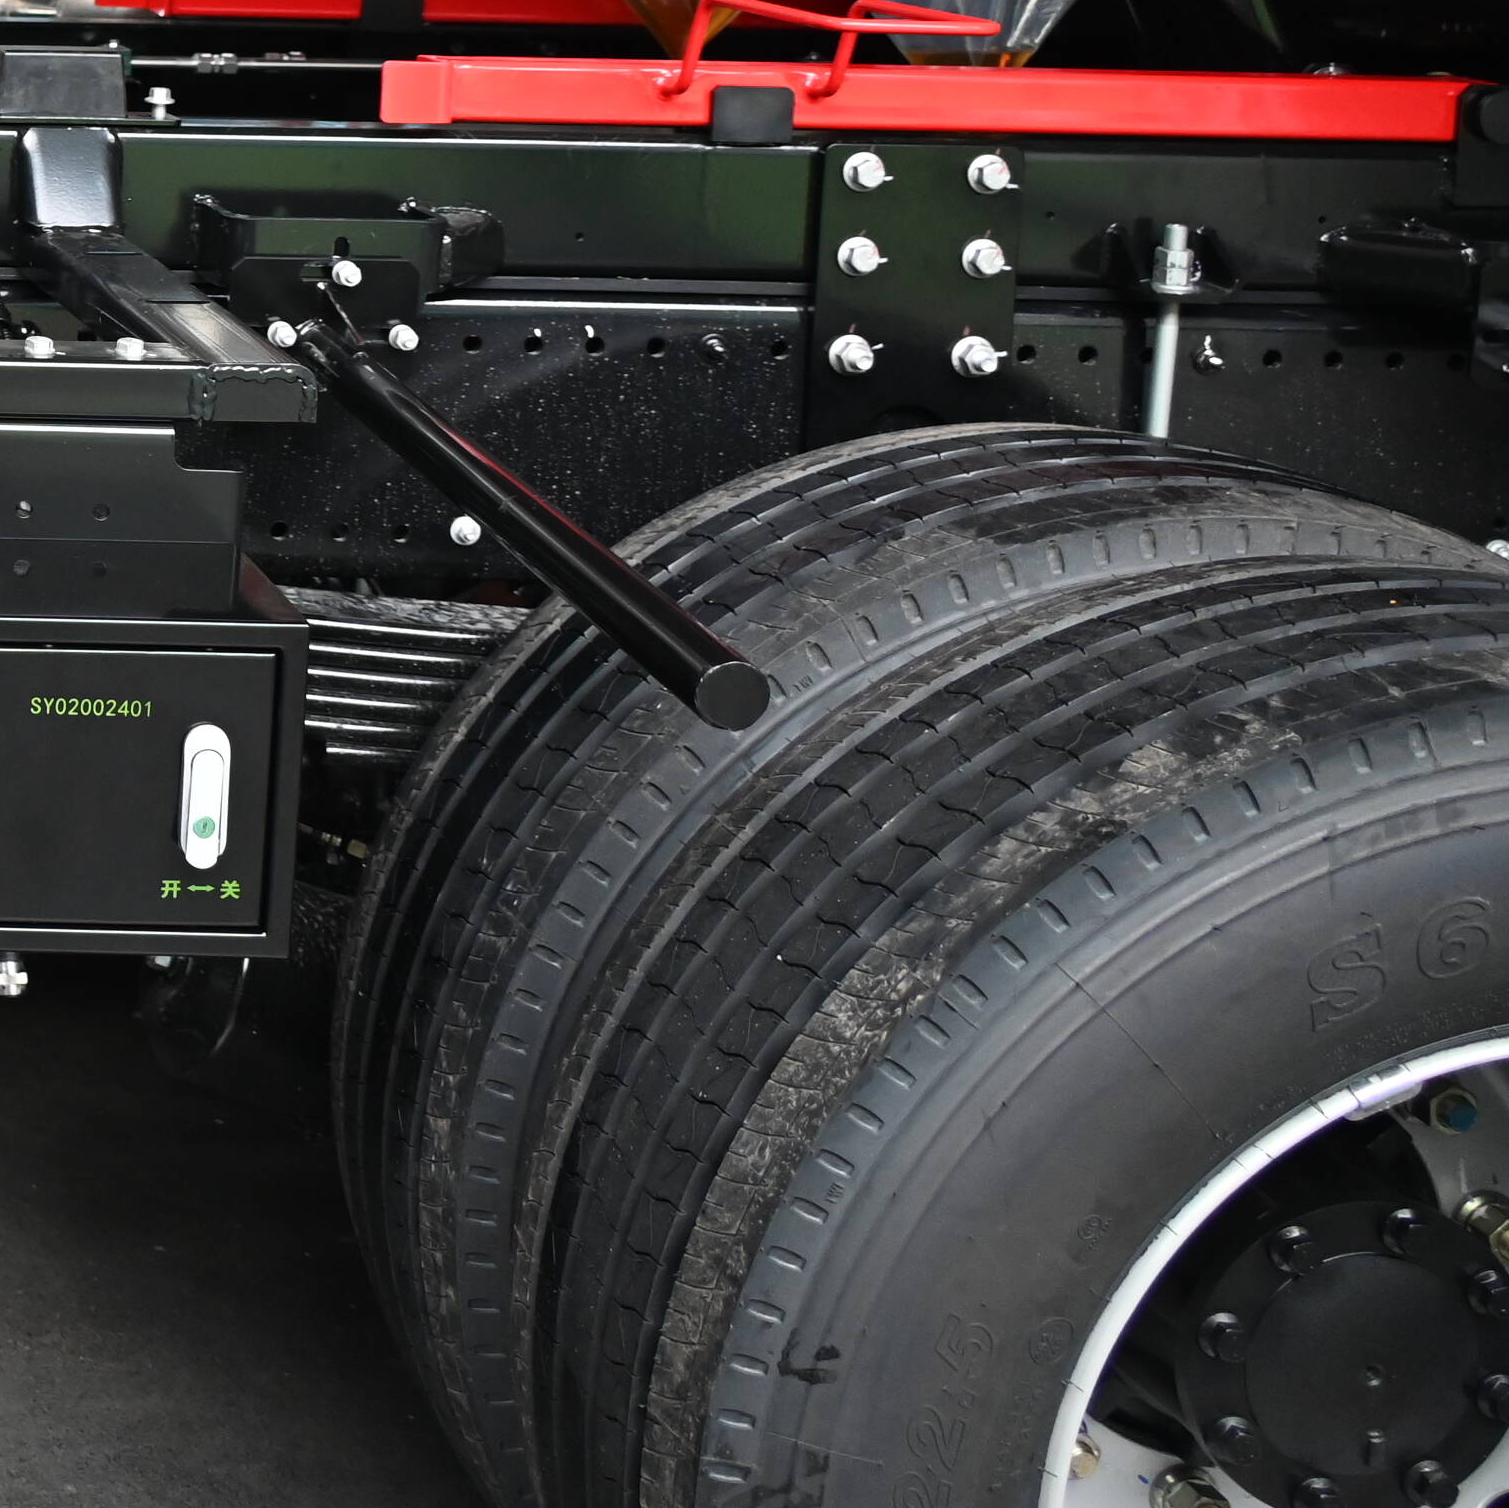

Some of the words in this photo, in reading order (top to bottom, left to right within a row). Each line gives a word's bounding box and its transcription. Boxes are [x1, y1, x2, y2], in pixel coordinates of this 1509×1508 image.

[29, 696, 153, 718] SY02002401
[160, 879, 182, 900] 开
[220, 879, 241, 900] 关
